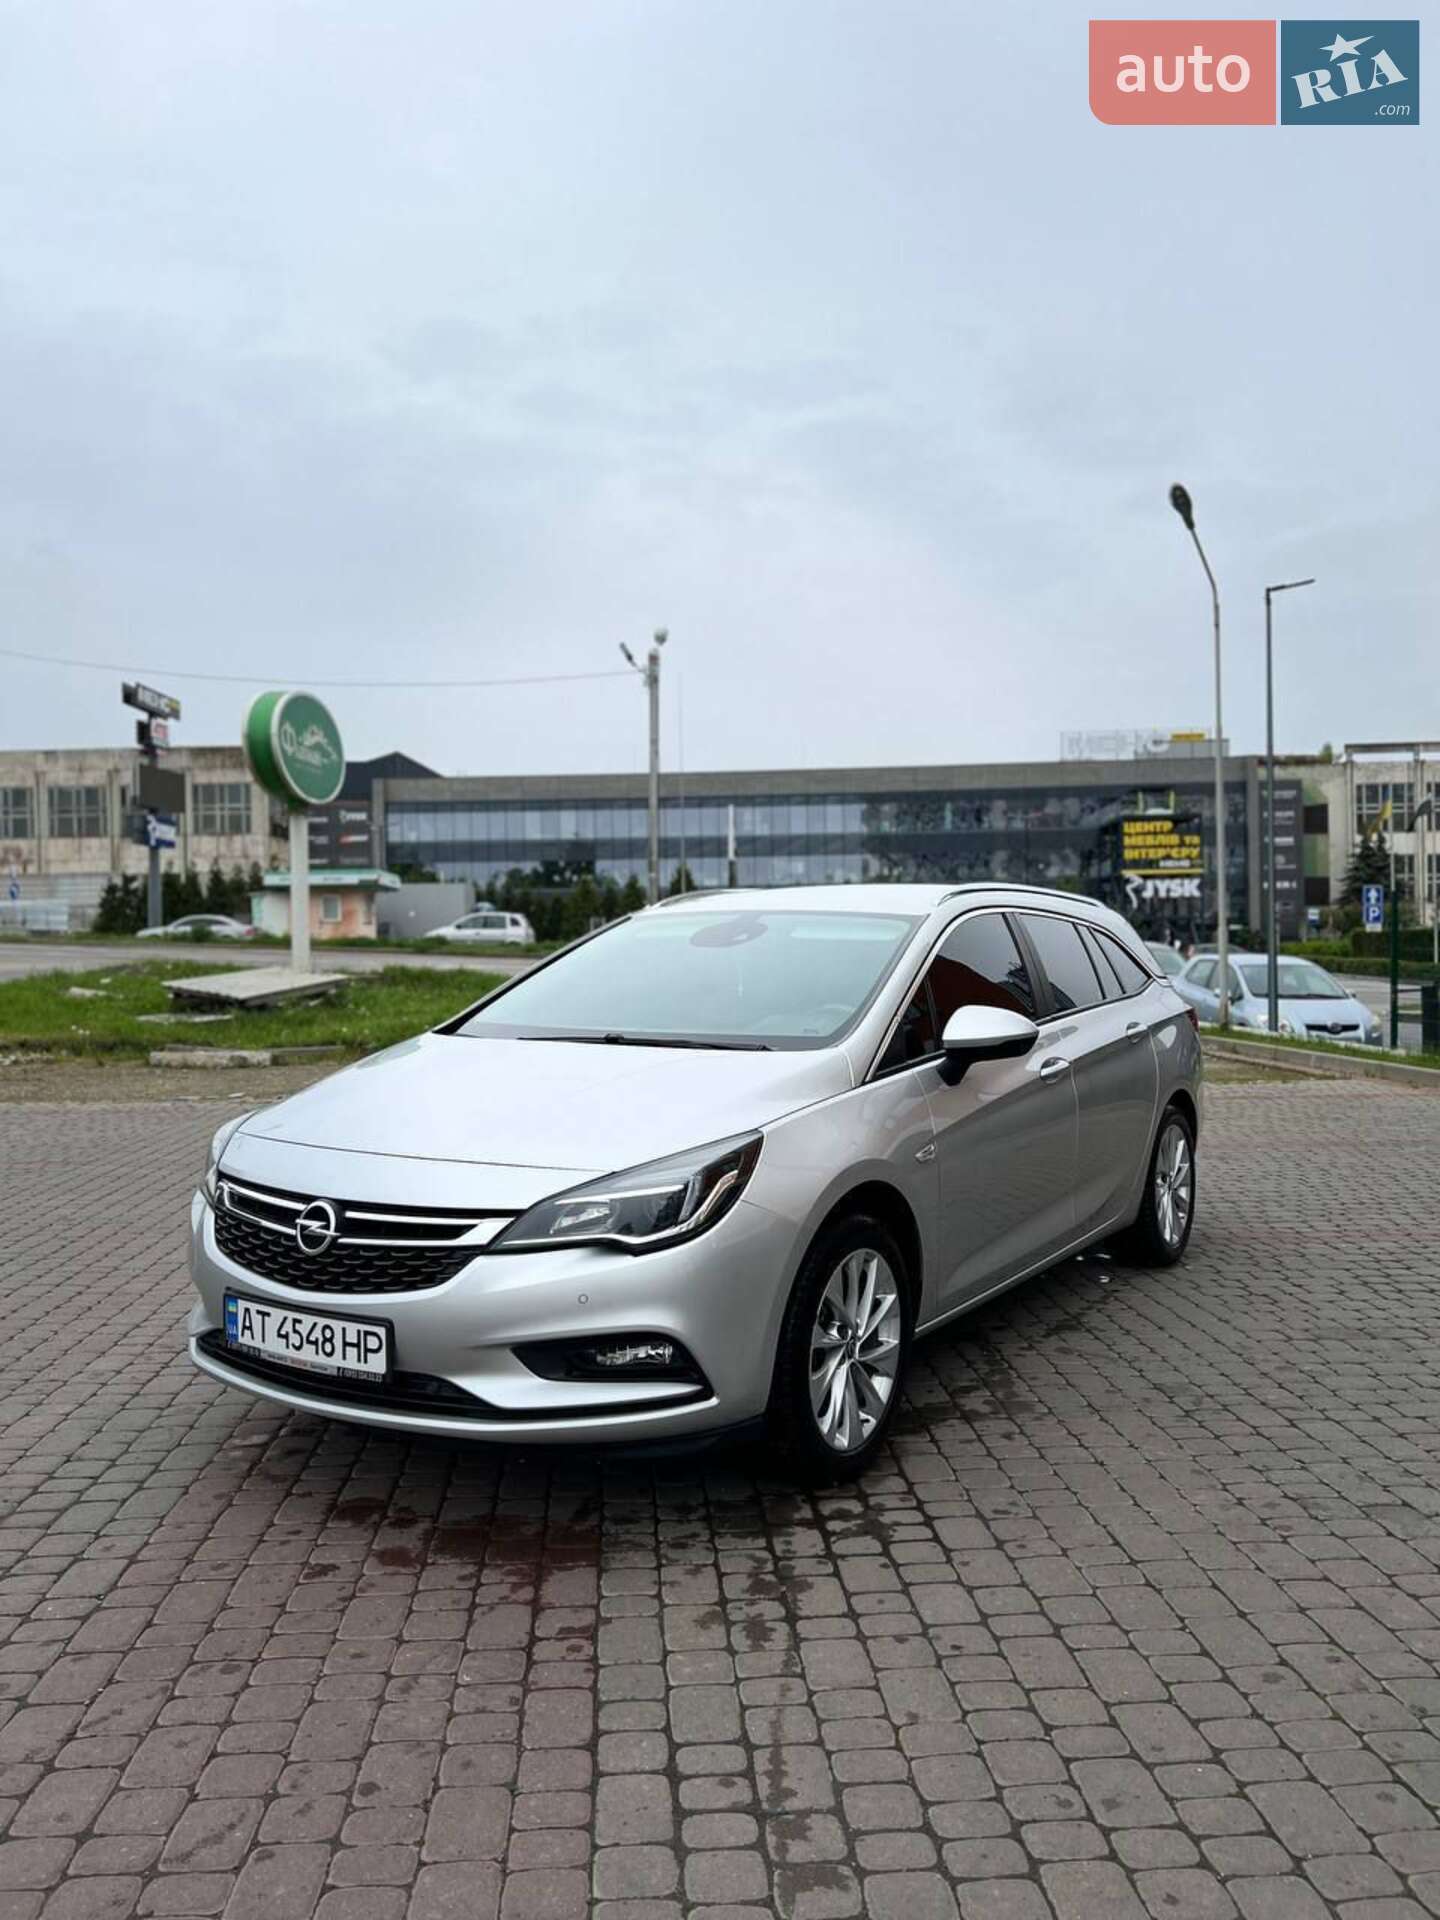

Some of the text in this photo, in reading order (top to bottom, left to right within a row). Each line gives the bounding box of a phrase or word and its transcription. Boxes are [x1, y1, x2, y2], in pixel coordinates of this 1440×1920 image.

[1123, 820, 1173, 834] ЦЕНТР
[1141, 878, 1201, 898] JYSK
[1368, 906, 1380, 922] P
[240, 1307, 271, 1344] AT
[276, 1316, 335, 1358] 4548
[341, 1327, 383, 1364] HP
